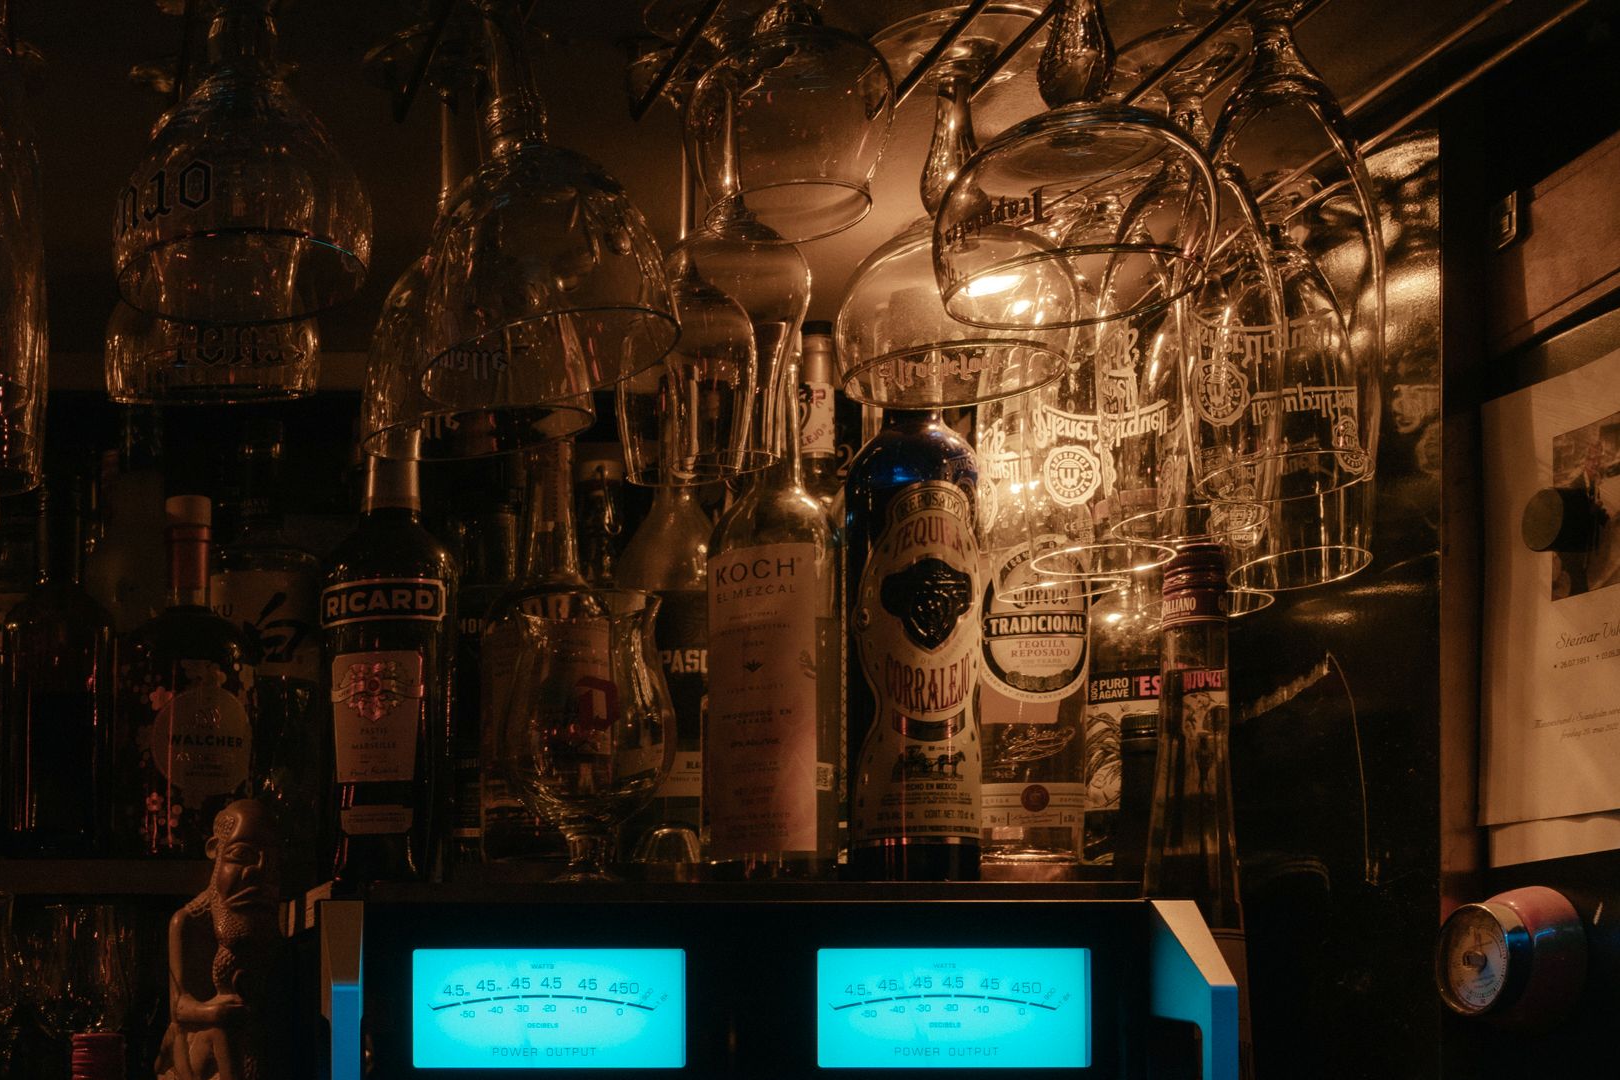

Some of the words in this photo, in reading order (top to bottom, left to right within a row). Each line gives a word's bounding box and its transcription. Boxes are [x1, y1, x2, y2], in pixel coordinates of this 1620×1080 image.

[898, 490, 962, 515] REPOSADO
[716, 557, 795, 588] KOCH
[716, 593, 729, 604] EL
[733, 583, 797, 600] MEZCAL
[326, 588, 435, 618] RICARD
[1163, 597, 1197, 615] ALLIANO
[990, 615, 1084, 636] TRADICIONAL
[1015, 639, 1068, 649] TEQUILA
[1555, 631, 1601, 650] Steinar
[1011, 648, 1071, 658] REPOSADO
[884, 652, 971, 714] CORRALEJO
[1099, 677, 1128, 691] PURO
[1099, 687, 1129, 700] AGAVE
[170, 734, 243, 748] WALCHER
[936, 783, 958, 791] MEXICO
[540, 976, 562, 990] 4.5
[578, 978, 598, 991] 45
[608, 982, 640, 995] 450
[942, 976, 964, 989] 4.5
[980, 977, 1000, 990] 45
[1011, 981, 1042, 994] 450
[459, 1010, 476, 1019] -50
[488, 1006, 504, 1014] -40
[513, 1004, 530, 1013] -30
[541, 1004, 557, 1013] -20
[571, 1006, 587, 1014] -10
[616, 1008, 624, 1017] 0
[888, 1005, 905, 1014] -40
[915, 1004, 932, 1013] -30
[973, 1005, 989, 1014] -10
[1018, 1007, 1026, 1016] 0
[492, 1047, 538, 1057] POWER
[546, 1047, 597, 1057] OUTPUT
[894, 1046, 940, 1057] POWER
[948, 1046, 999, 1057] OUTPUT
